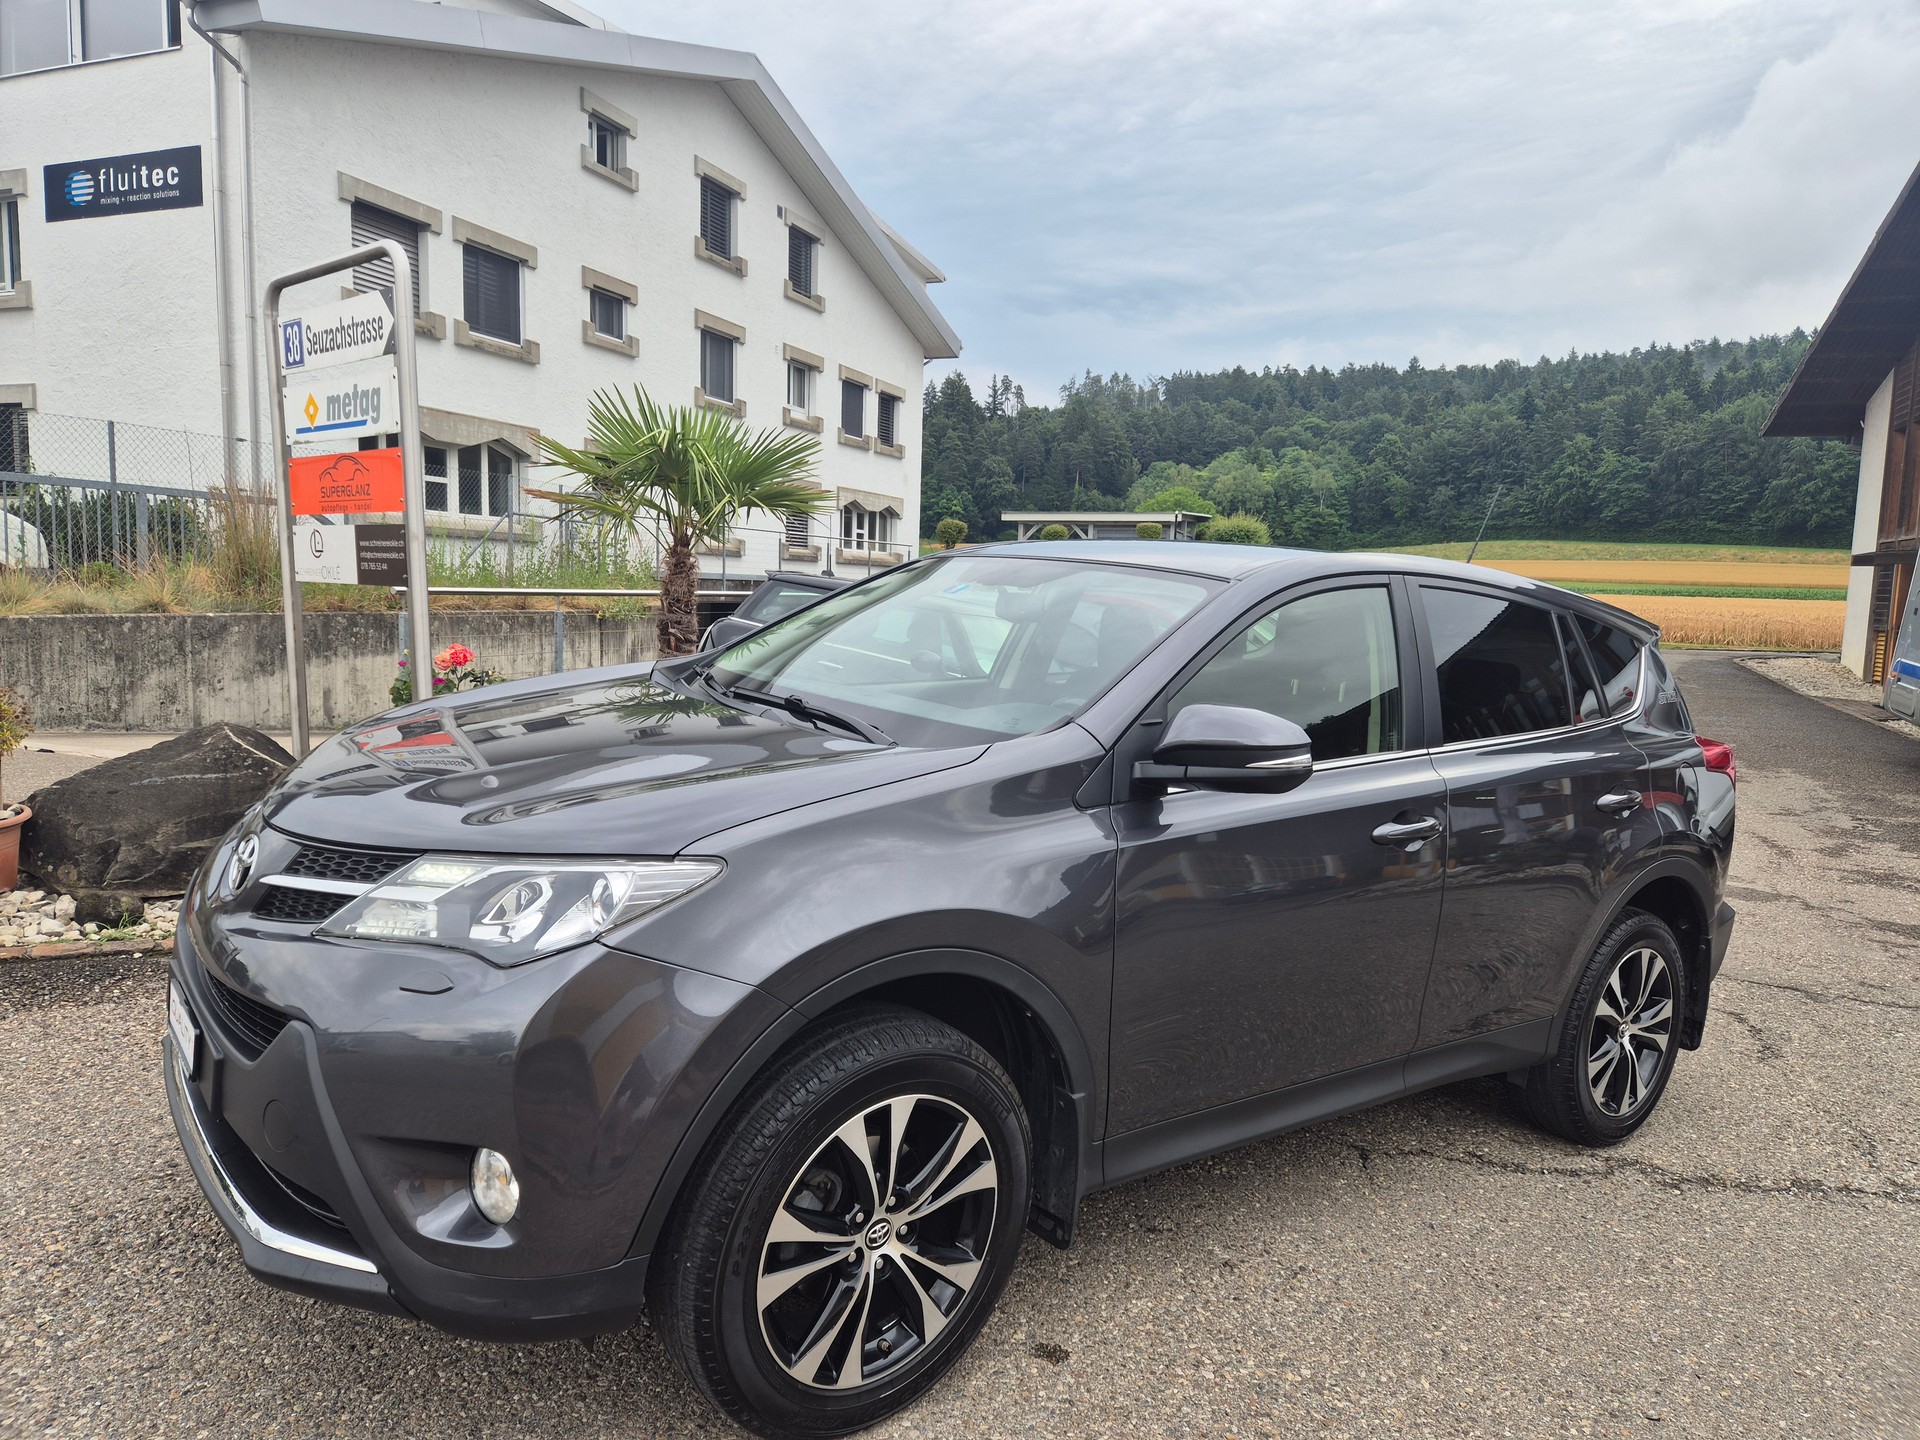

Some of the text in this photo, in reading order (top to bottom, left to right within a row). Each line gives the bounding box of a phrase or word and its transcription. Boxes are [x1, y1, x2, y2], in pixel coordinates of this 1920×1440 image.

[98, 165, 179, 193] fluitec
[100, 196, 119, 205] mixing
[126, 192, 151, 202] reaction
[153, 189, 180, 199] solutions
[286, 315, 384, 364] 38 Seuzachstrasse
[326, 383, 381, 425] metag
[320, 483, 371, 499] SUPERGLANZ
[321, 503, 349, 512] autopflege
